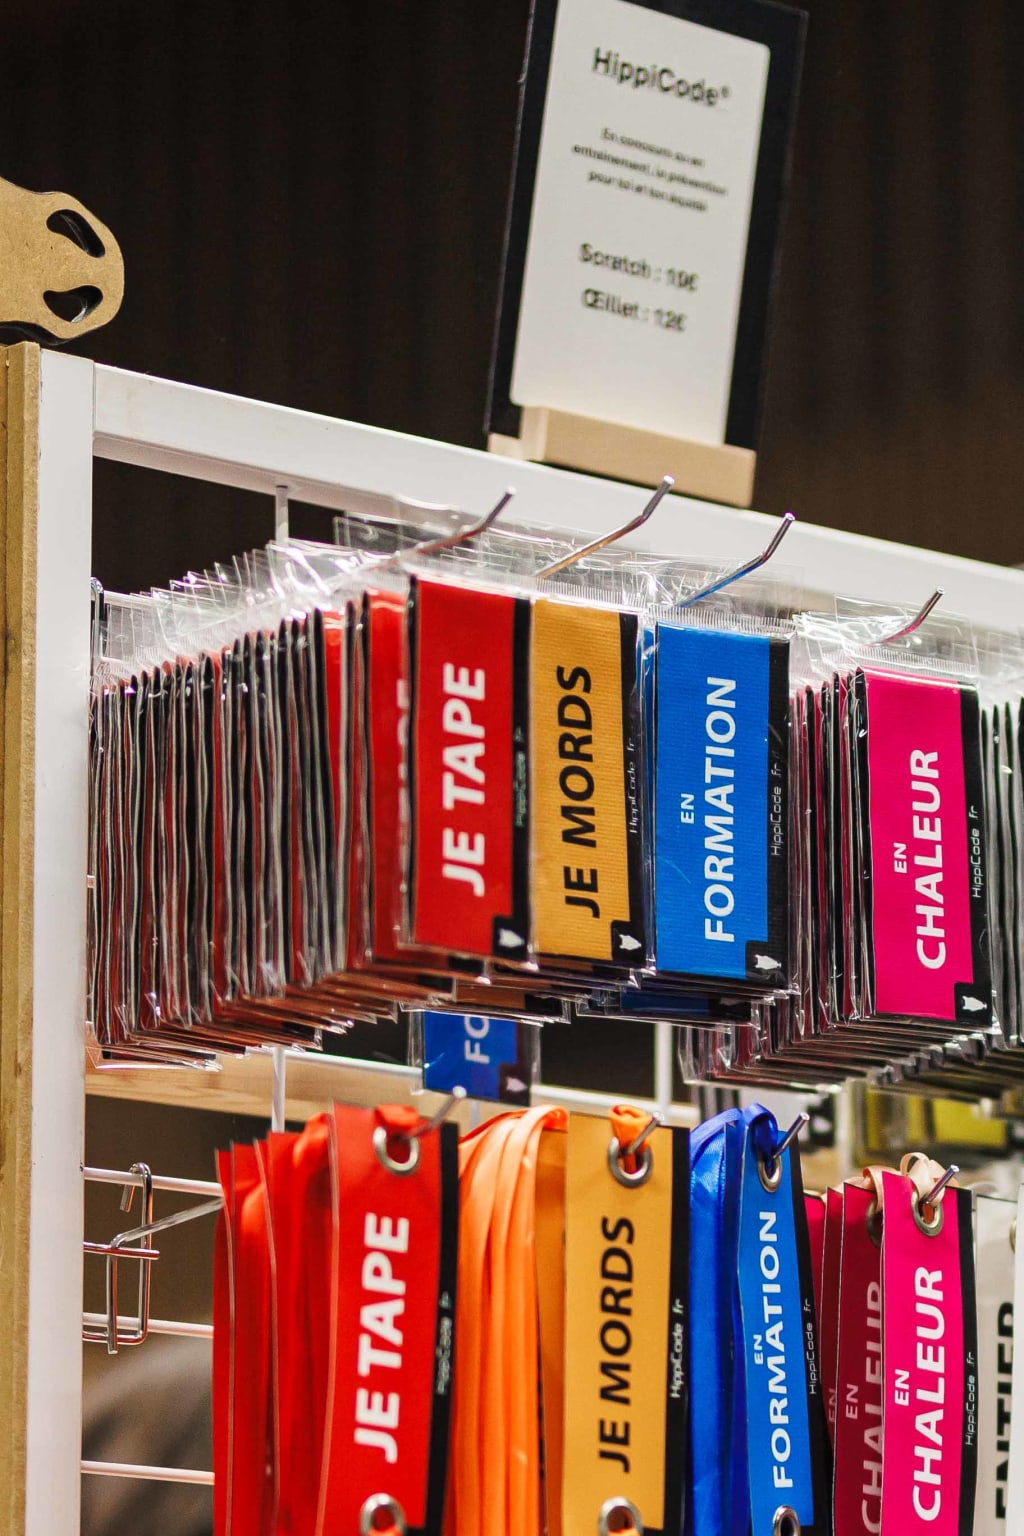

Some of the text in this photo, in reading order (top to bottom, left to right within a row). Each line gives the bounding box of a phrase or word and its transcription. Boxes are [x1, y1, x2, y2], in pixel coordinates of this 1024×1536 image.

[579, 242, 652, 280] Scratch
[443, 662, 485, 897] JE TAPE
[556, 665, 600, 919] JE MORDS
[680, 792, 695, 825] EN
[704, 676, 736, 943] FORMATION
[769, 785, 784, 857] HippiCode
[893, 842, 907, 874] EN
[909, 748, 946, 970] CHALEUR
[970, 826, 982, 898] HippiCode
[354, 1212, 410, 1464] JE TAPE
[598, 1216, 635, 1474] JE MORDS
[753, 1334, 764, 1365] EN
[759, 1211, 793, 1489] FORMATION
[805, 1322, 818, 1396] HippiCode
[845, 1383, 859, 1421] EN
[894, 1369, 910, 1407] EN
[912, 1265, 945, 1521] CHALEUR
[964, 1374, 976, 1447] HippiCode
